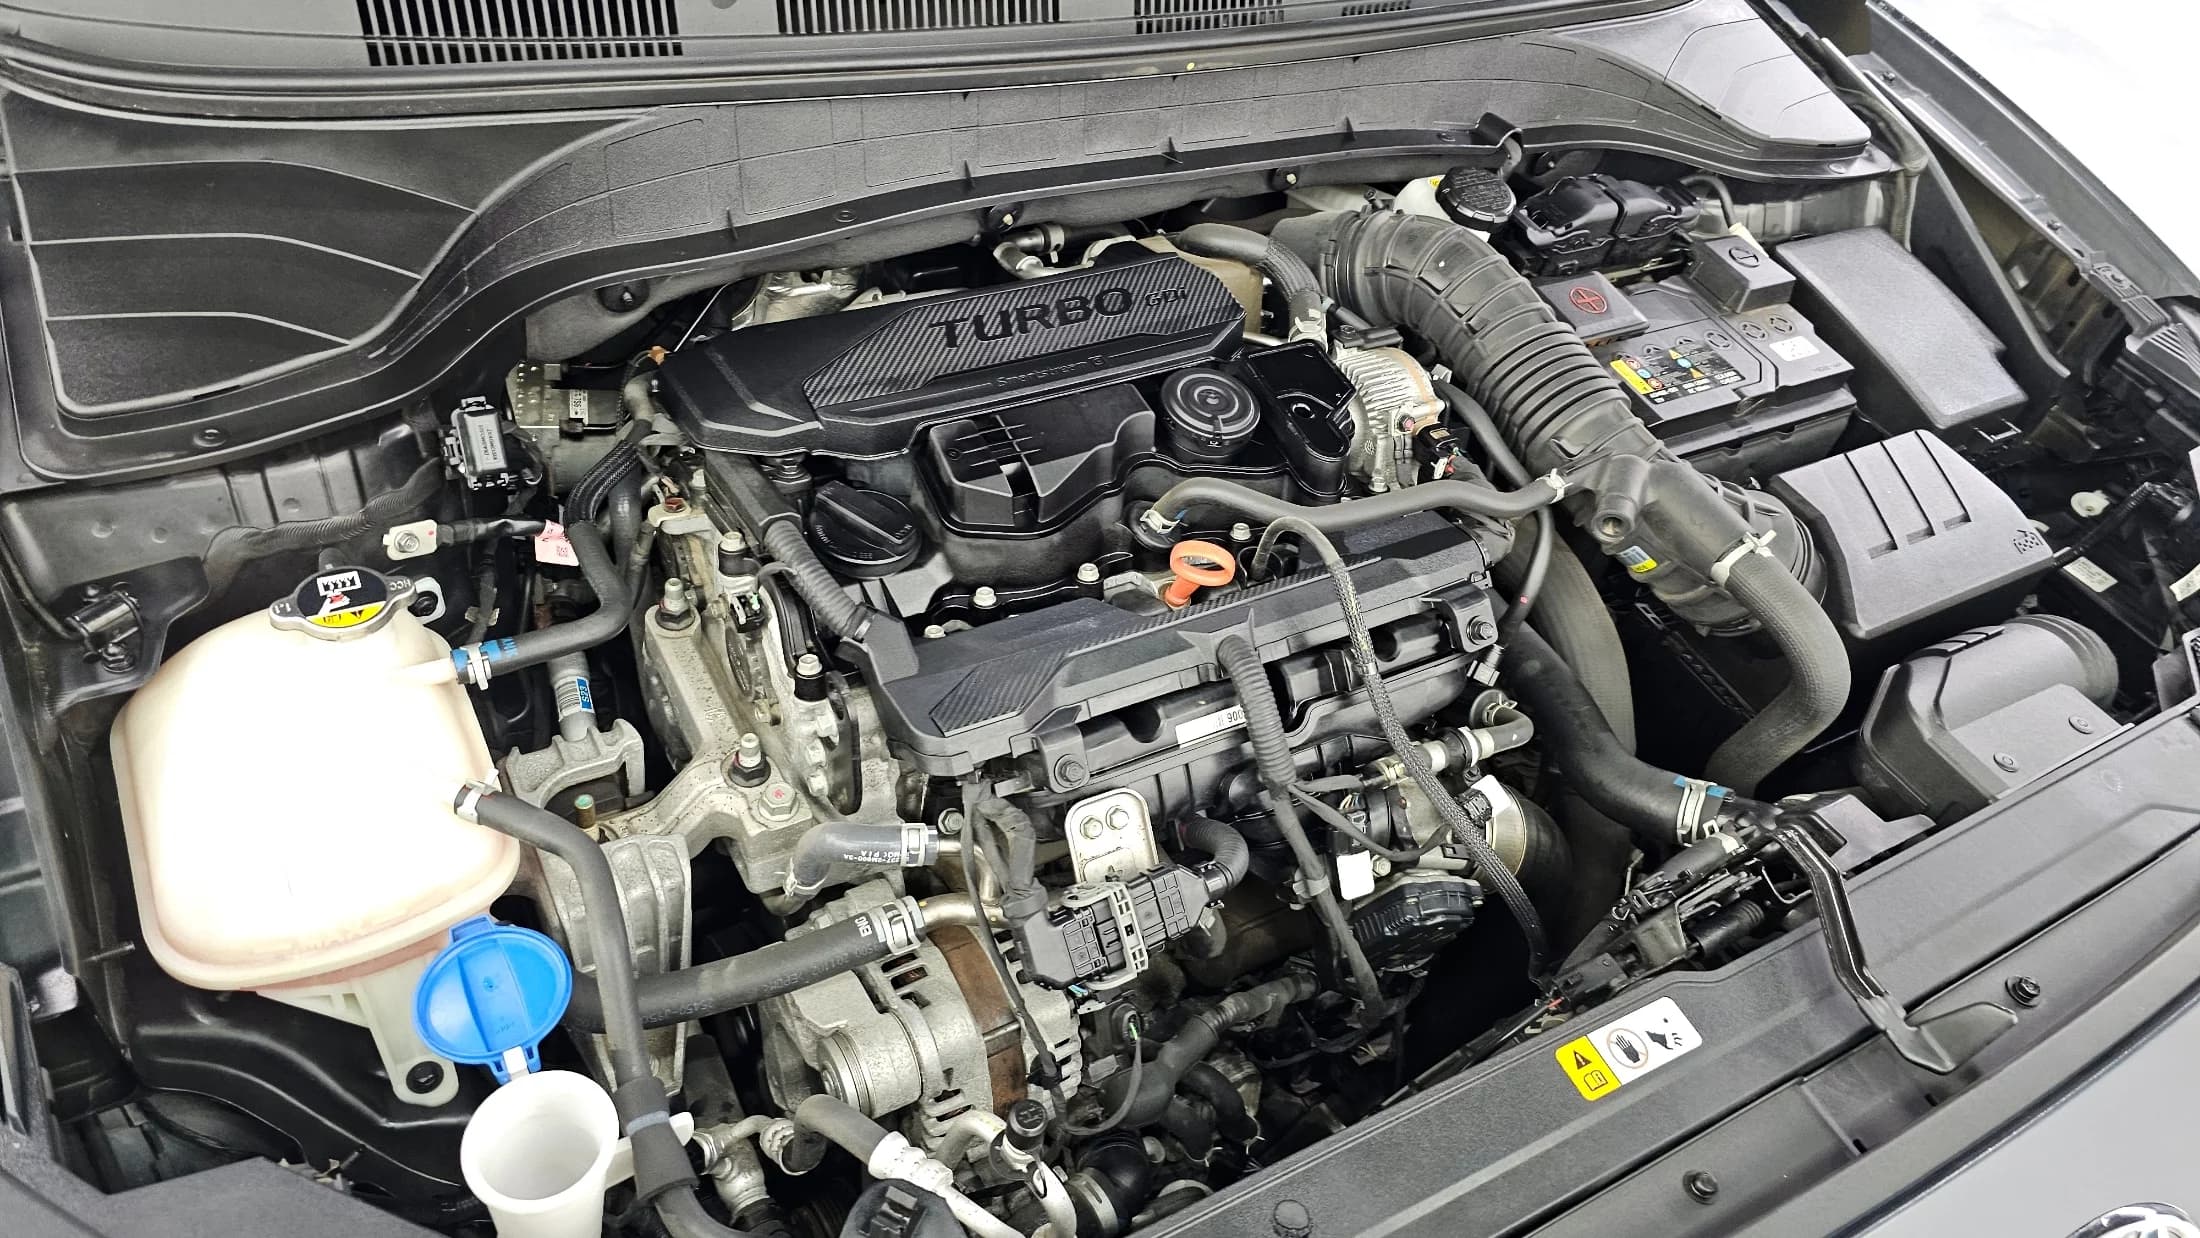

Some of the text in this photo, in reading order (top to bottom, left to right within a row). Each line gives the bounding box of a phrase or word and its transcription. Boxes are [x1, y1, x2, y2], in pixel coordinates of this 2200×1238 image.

[928, 288, 1133, 349] TURBO
[389, 578, 413, 592] HCC
[854, 916, 872, 937] ENG
